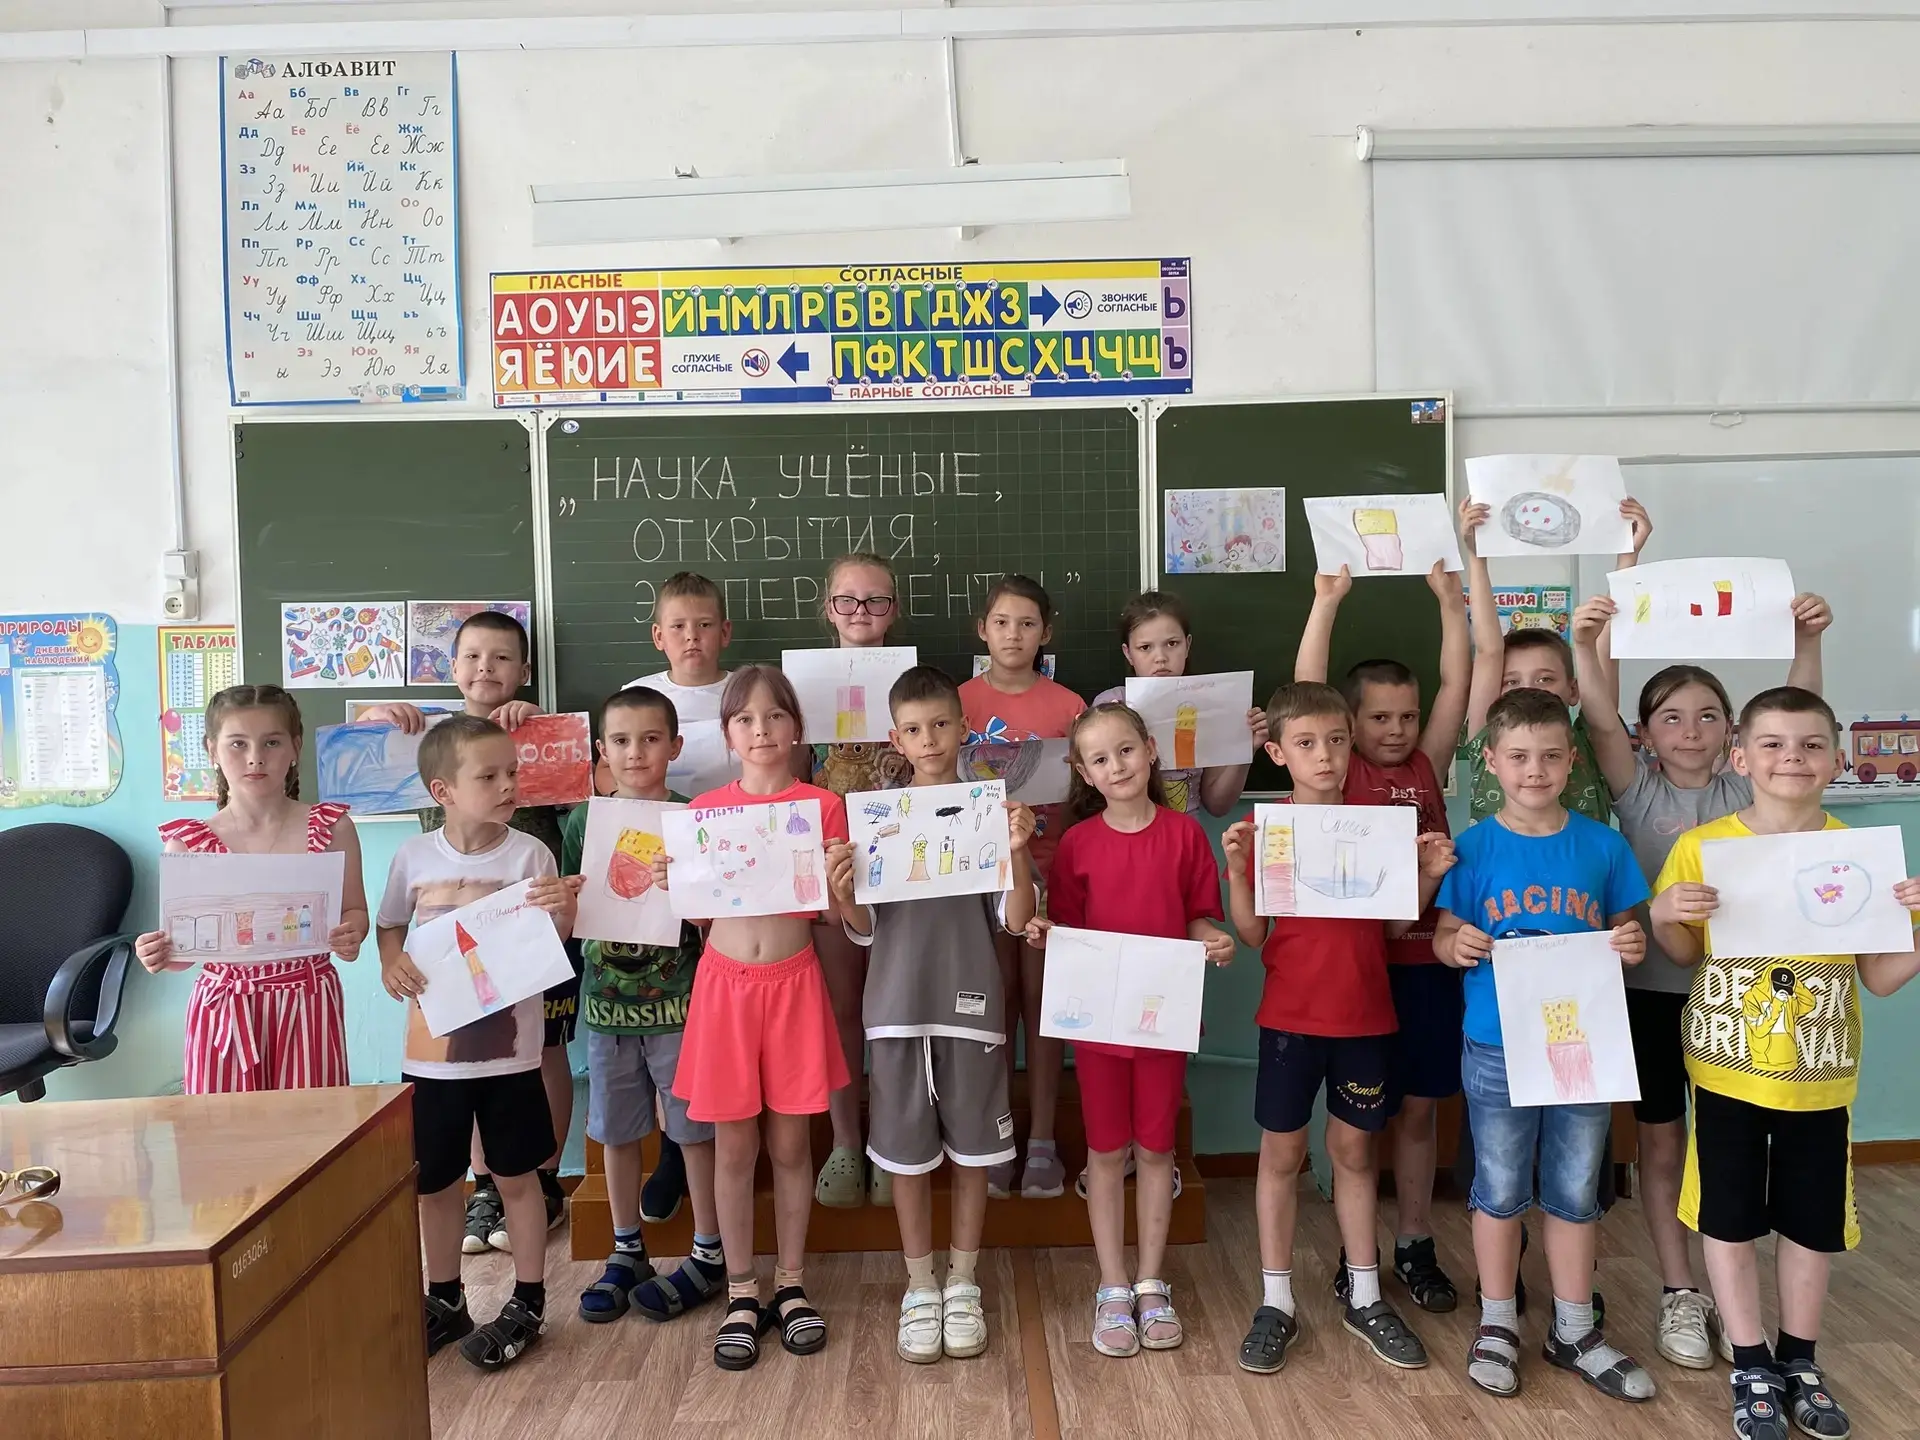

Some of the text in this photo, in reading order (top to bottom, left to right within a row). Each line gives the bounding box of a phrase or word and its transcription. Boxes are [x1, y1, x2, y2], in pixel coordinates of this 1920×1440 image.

[282, 61, 396, 78] АЛФАВИТ
[239, 86, 409, 99] Аа Бб Вв Гг
[239, 123, 423, 138] Дд Ее Ёё Жж
[840, 266, 963, 282] СОГЛАСНЫЕ
[529, 274, 622, 290] ГЛАСНЫЕ
[1102, 293, 1147, 303] ЗВОНКИЕ
[1164, 286, 1186, 318] Ь
[1097, 302, 1158, 312] СОГЛАСНЫЕ
[683, 354, 721, 362] ГЛУХИЕ
[672, 363, 733, 373] СОГЛАСНЫЕ
[850, 384, 1014, 399] ПАРНЫЕ СОГЛАСНЫЕ
[35, 647, 78, 655] ДНЕВНИК
[25, 656, 90, 664] НАБЛЮДЕНИЙ
[518, 739, 583, 763] ОСТЬ
[1391, 786, 1417, 799] EST
